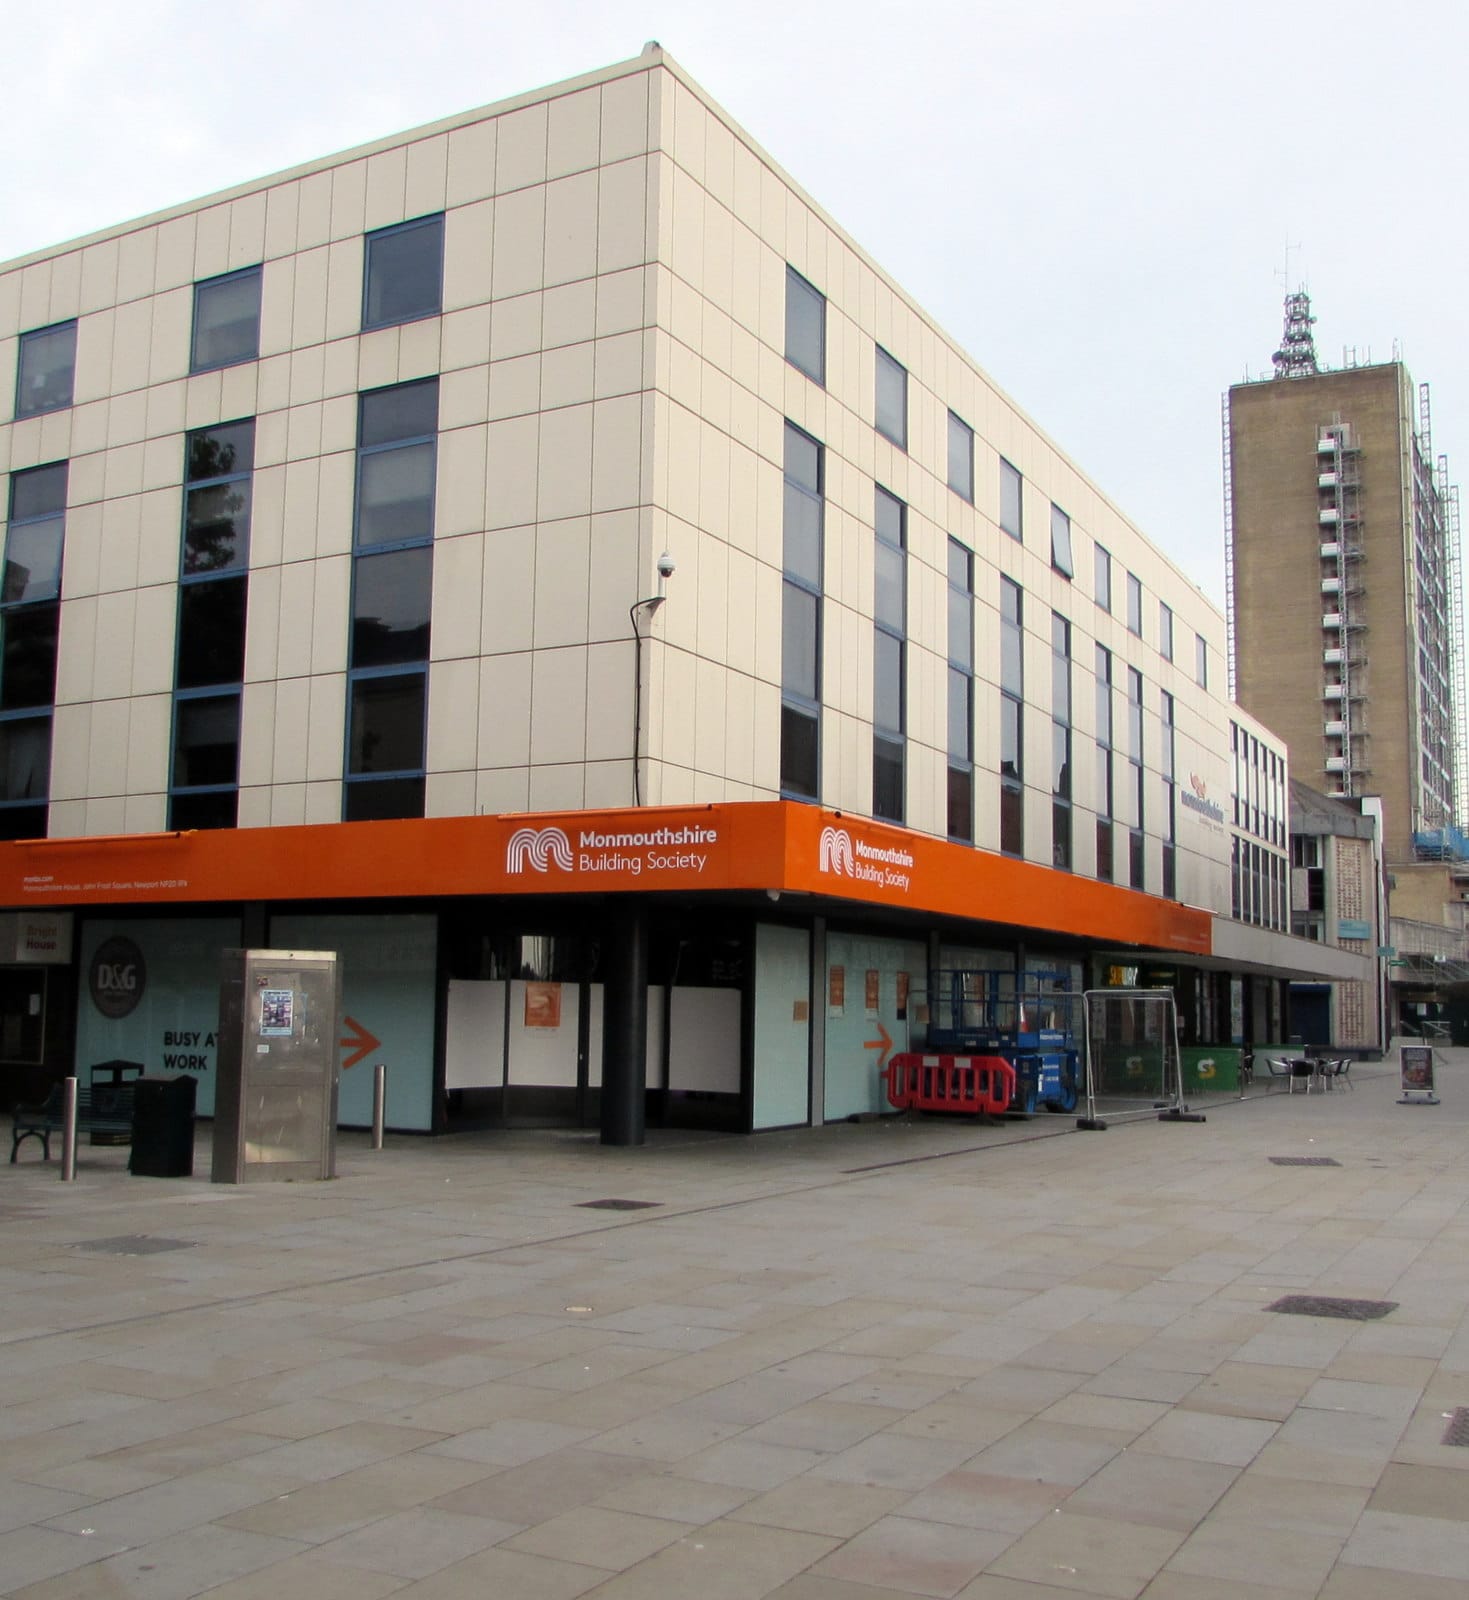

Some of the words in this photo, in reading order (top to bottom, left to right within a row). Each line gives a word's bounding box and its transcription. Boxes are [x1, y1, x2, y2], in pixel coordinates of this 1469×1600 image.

[579, 825, 717, 848] Monmouthshire
[579, 854, 641, 875] Building
[647, 851, 707, 872] Society
[855, 839, 914, 868] Monmouthshire
[855, 861, 884, 888] Building
[885, 866, 910, 893] Society
[26, 925, 57, 938] Bright
[26, 938, 57, 950] House
[97, 963, 136, 990] D&G
[163, 1031, 202, 1047] BUSY
[163, 1053, 208, 1071] WORK
